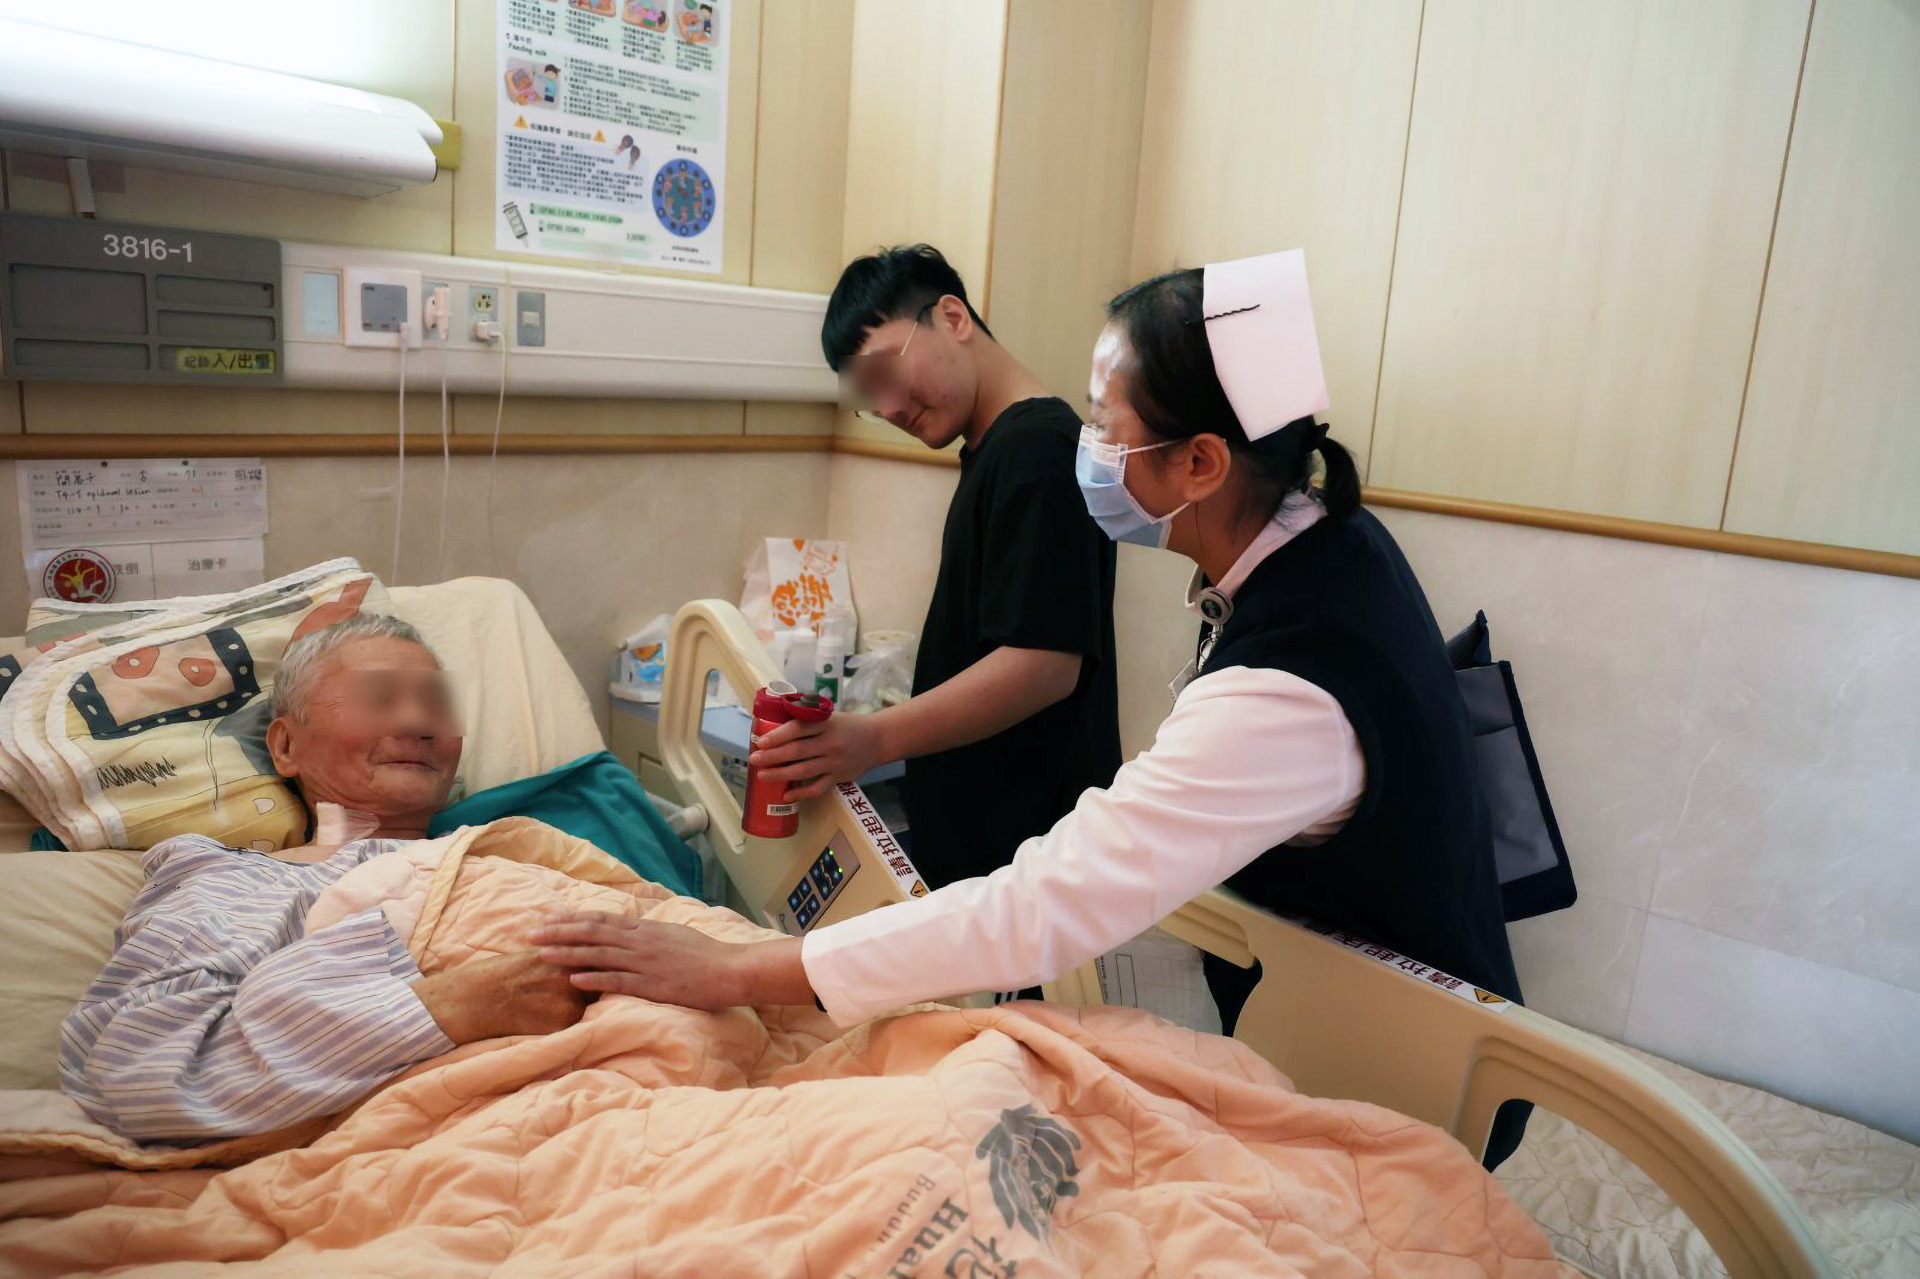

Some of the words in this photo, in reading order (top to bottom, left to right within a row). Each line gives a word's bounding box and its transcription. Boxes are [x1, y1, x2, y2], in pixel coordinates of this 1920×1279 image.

[103, 233, 192, 262] 3816-1
[187, 557, 227, 571] 治療卡
[1306, 921, 1464, 991] 請拉起床
